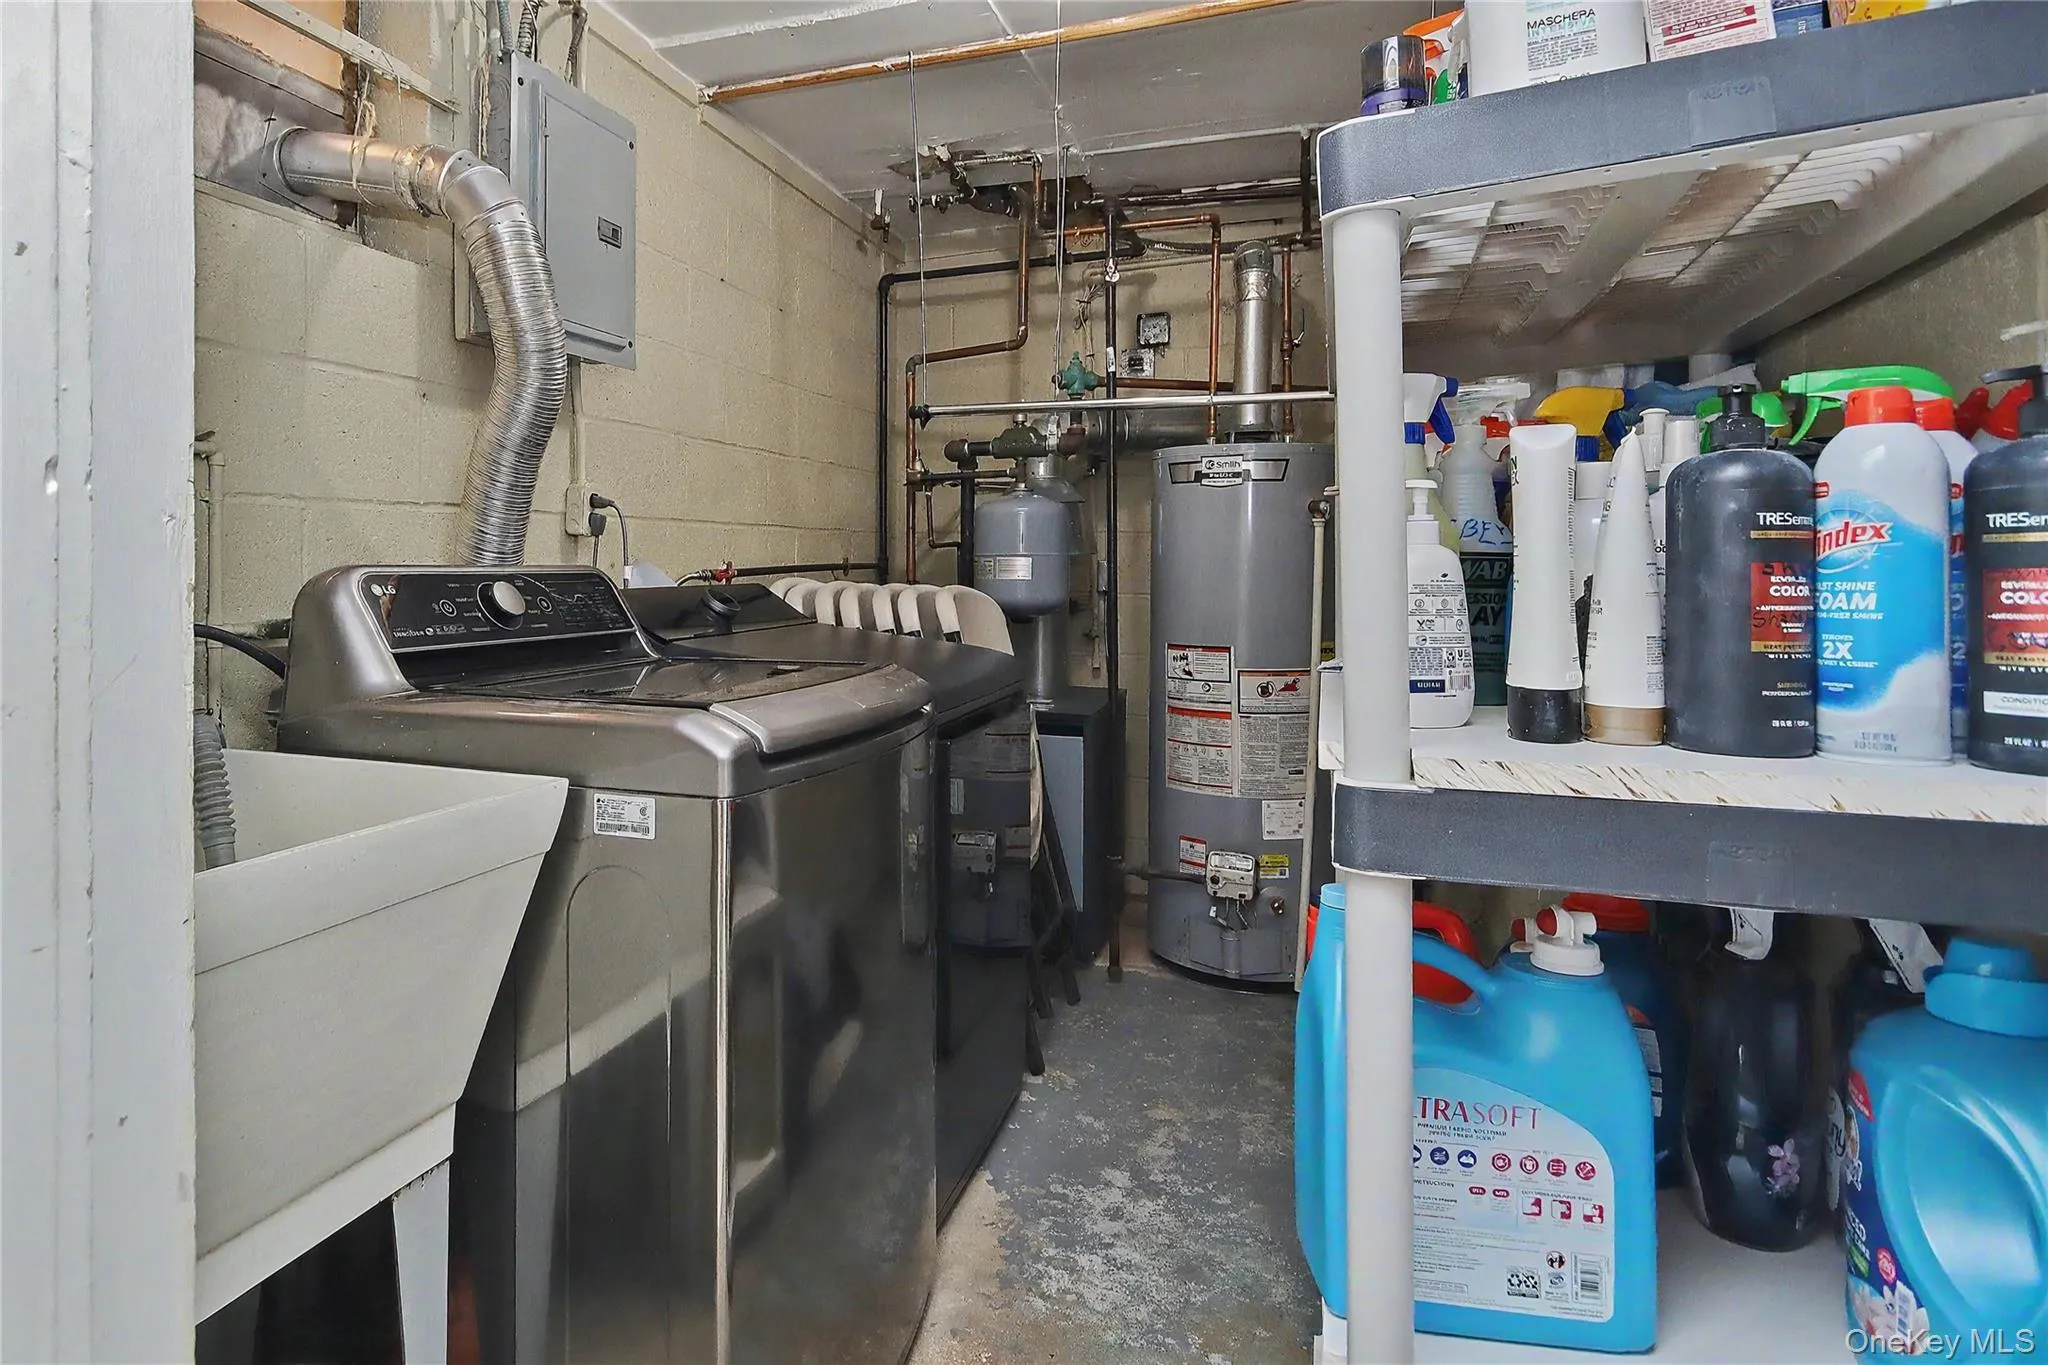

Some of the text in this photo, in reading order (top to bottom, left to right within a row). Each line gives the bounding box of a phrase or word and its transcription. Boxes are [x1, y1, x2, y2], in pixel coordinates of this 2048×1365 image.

[381, 585, 396, 595] LG
[1769, 585, 1811, 597] COLOR
[1834, 581, 1877, 591] SHINE
[1815, 592, 1878, 611] OAM
[1822, 640, 1854, 660] 2X
[1413, 1096, 1541, 1130] TRASOFT
